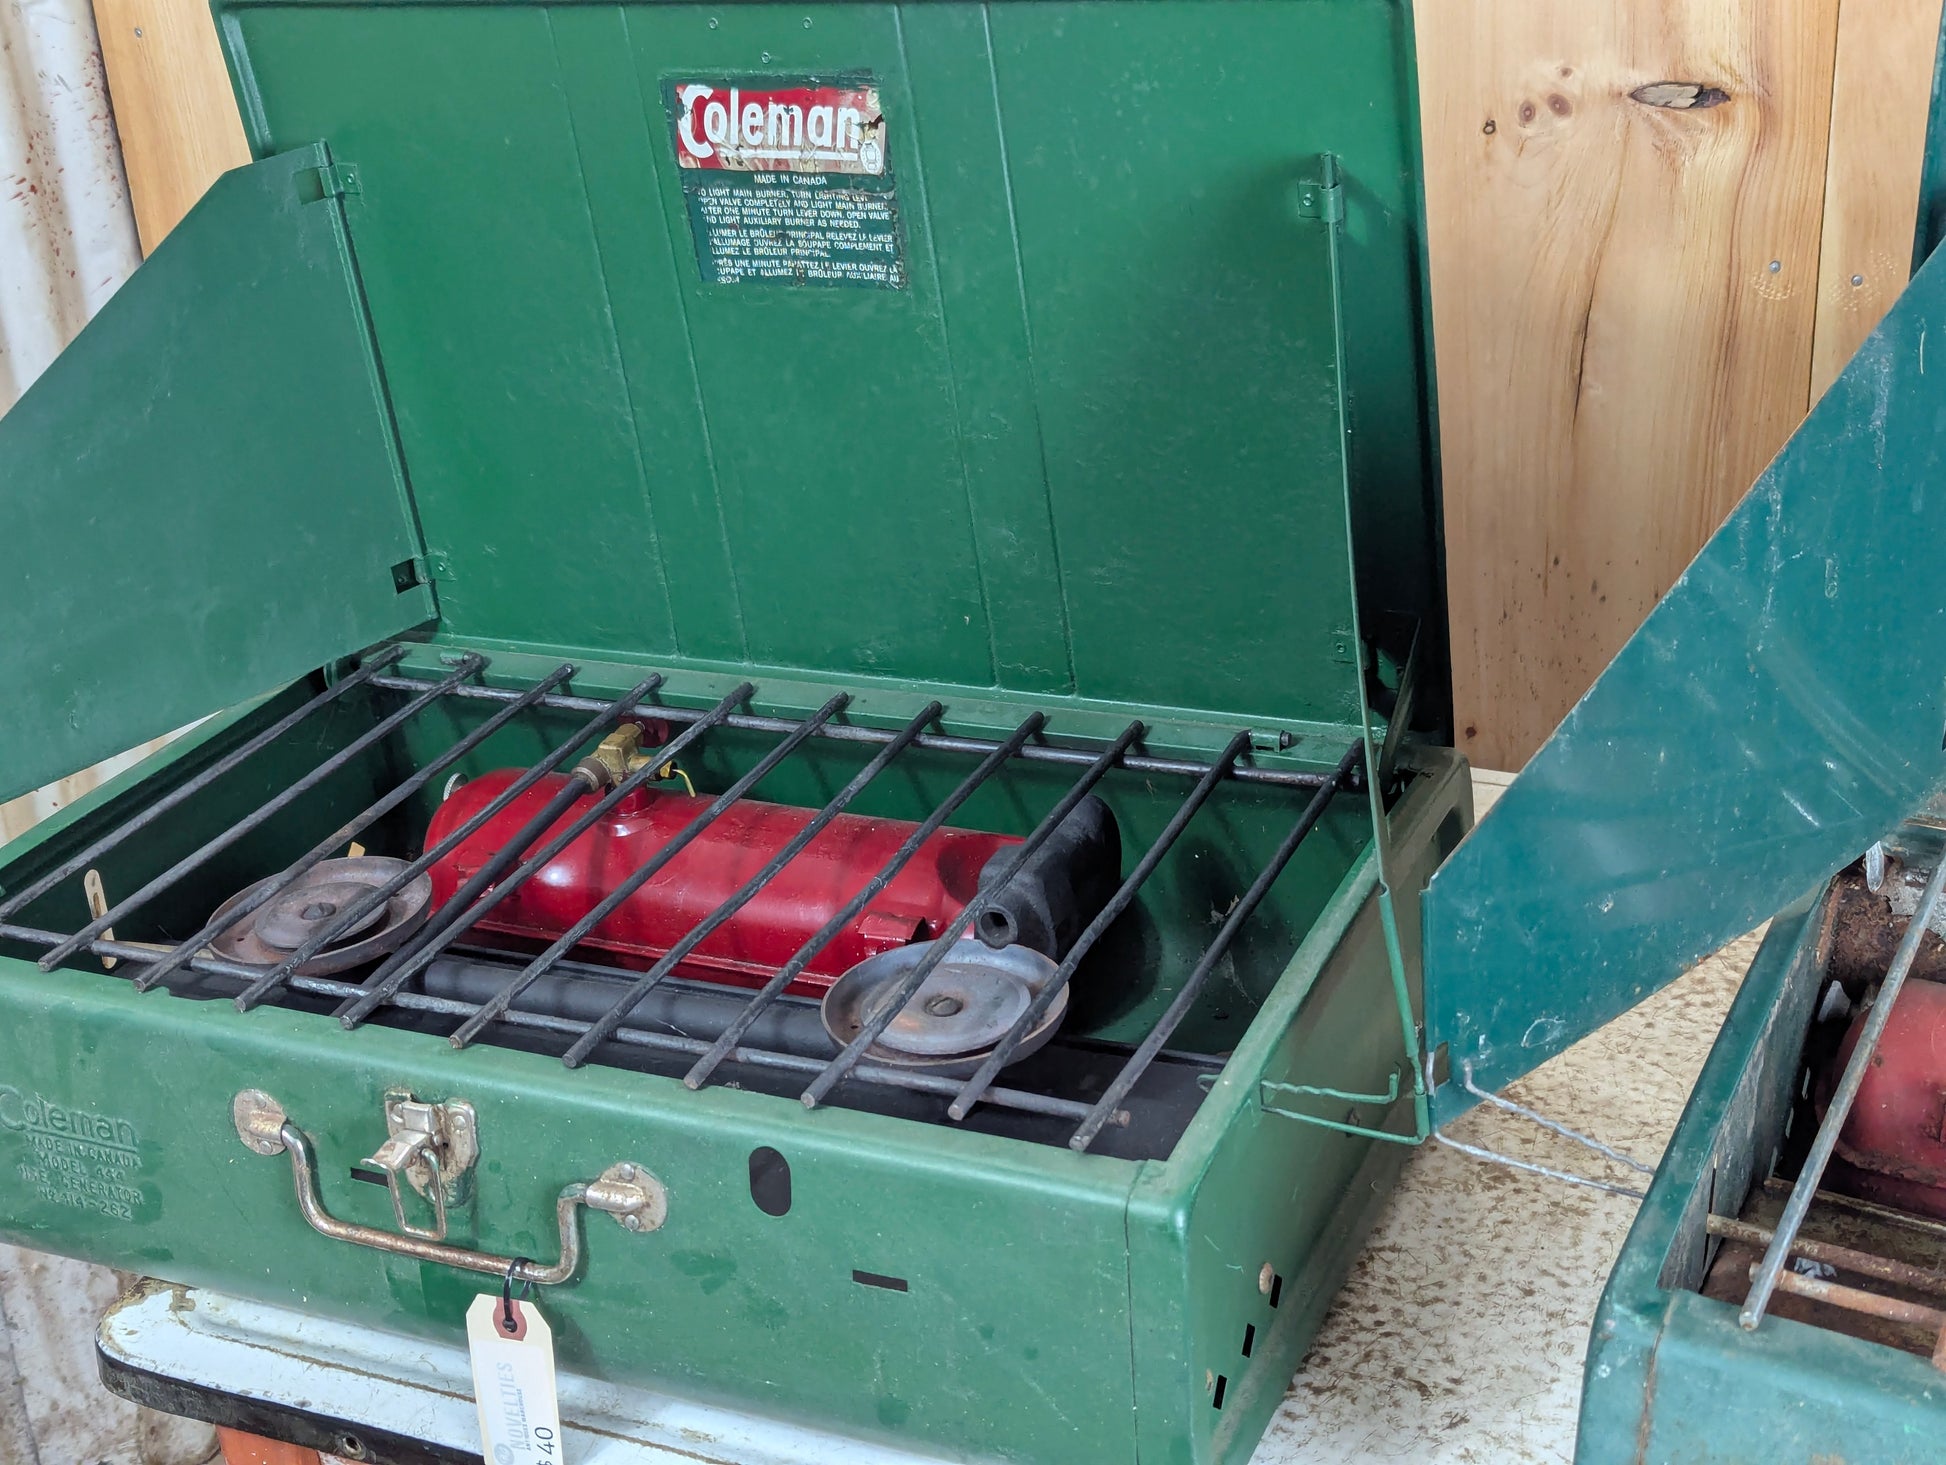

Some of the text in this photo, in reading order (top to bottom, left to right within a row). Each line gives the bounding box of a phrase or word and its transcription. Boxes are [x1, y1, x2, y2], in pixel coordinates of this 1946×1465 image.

[679, 85, 860, 158] Coleman
[754, 174, 827, 185] MADE IN CANADA
[698, 188, 706, 196] O
[709, 188, 730, 197] LIGHT
[733, 189, 752, 197] MAIN
[792, 190, 811, 199] TURN
[719, 198, 742, 206] VALVE
[744, 199, 791, 208] COMPLETELY
[811, 201, 832, 209] LIGHT
[835, 202, 855, 210] MAIN
[742, 208, 771, 216] MINUTE
[773, 209, 793, 217] TURN
[796, 210, 817, 218] LEVER
[847, 211, 867, 219] OPEN
[868, 212, 889, 220] VALVE
[719, 216, 740, 224] LIGHT
[744, 217, 782, 225] AUXILIARY
[785, 218, 814, 226] BURNER
[817, 219, 827, 227] AS
[739, 229, 748, 238] LE
[786, 239, 795, 247] LA
[743, 247, 751, 255] LE
[754, 246, 787, 256] BRÛLEUR
[735, 259, 750, 268] UNE
[752, 259, 781, 268] MINUTE
[832, 262, 857, 271] LEVIER
[748, 268, 756, 276] ET
[0, 1084, 140, 1148] Coleman
[25, 1134, 143, 1169] MADE IN CANADA
[38, 1151, 87, 1176] MODEL
[61, 1175, 144, 1205] GENERATOR
[496, 1361, 525, 1451] NOVELTIES
[534, 1427, 555, 1456] 40
